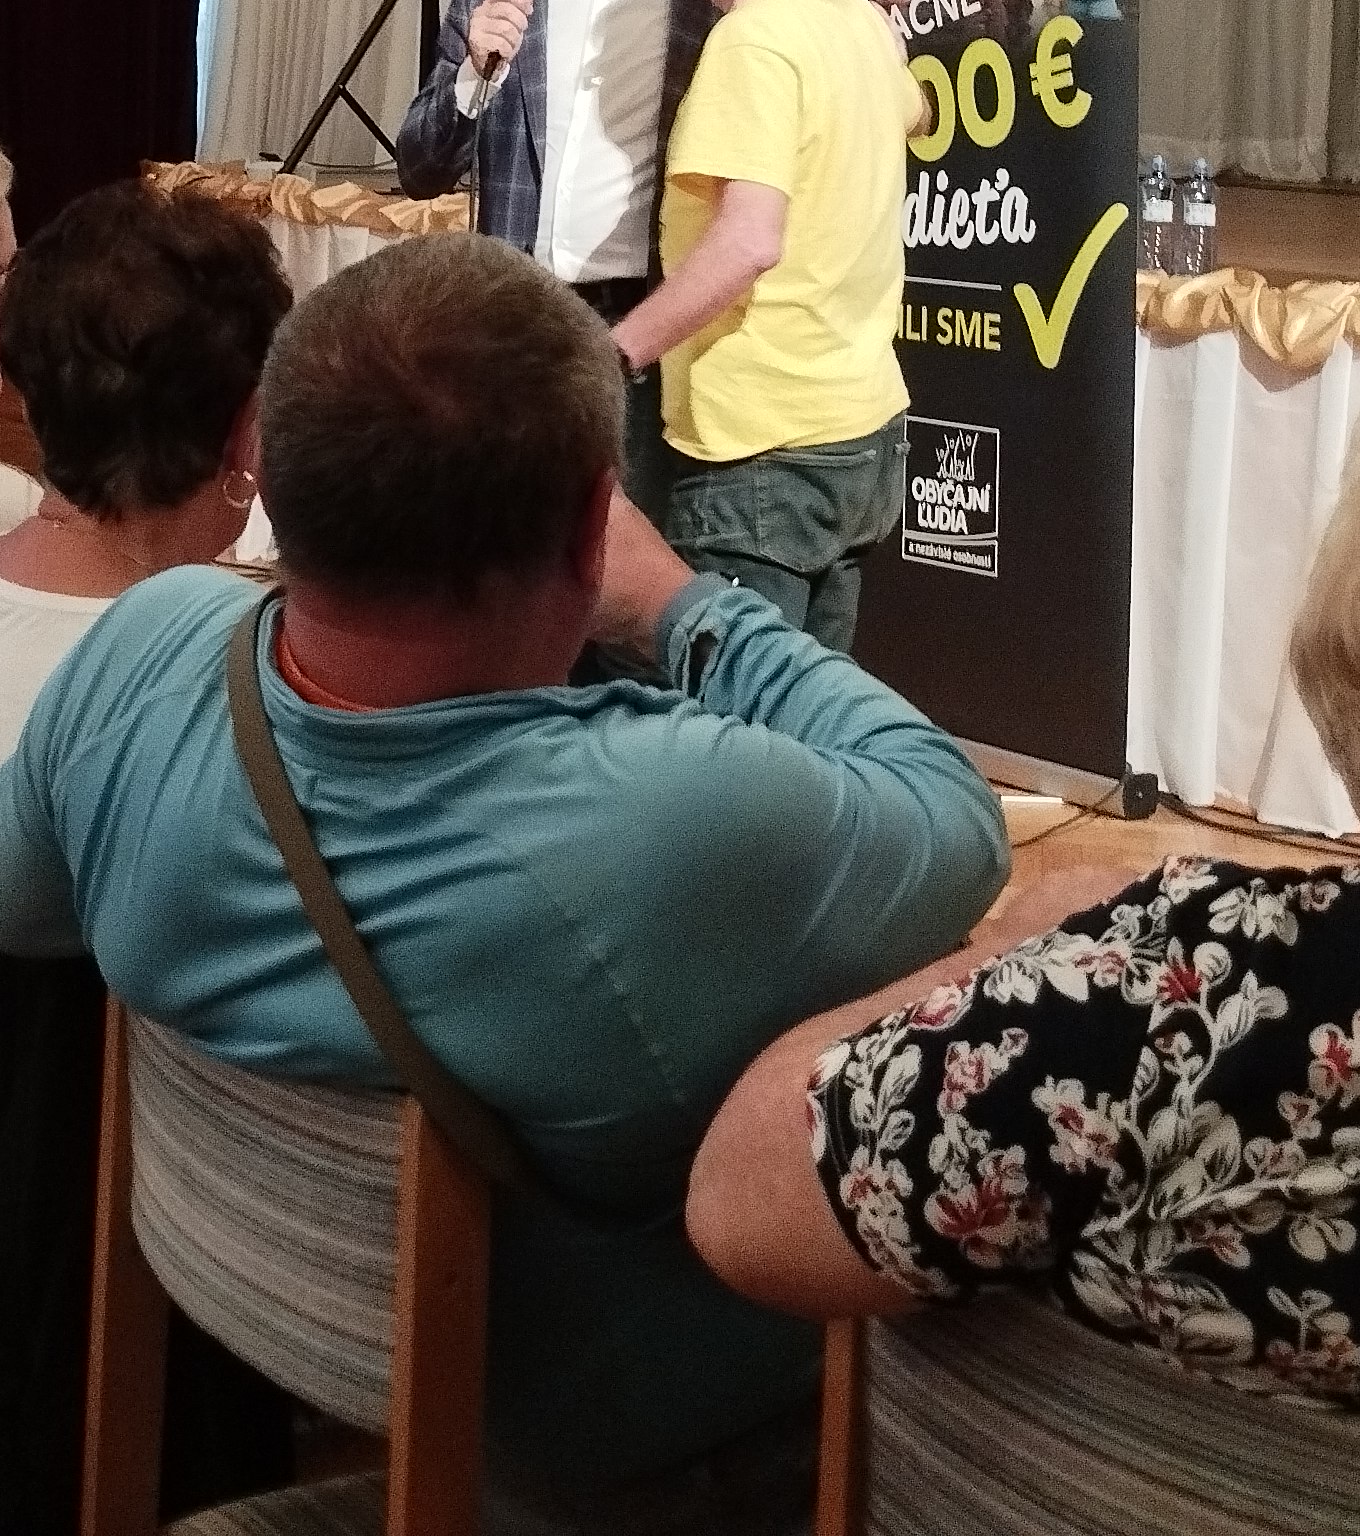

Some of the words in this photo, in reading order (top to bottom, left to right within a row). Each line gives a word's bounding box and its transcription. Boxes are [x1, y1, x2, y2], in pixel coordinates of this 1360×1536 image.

[1029, 14, 1093, 129] €
[902, 167, 1036, 250] dieťa
[936, 306, 1001, 351] SME
[911, 476, 991, 513] OBYČAJNÍ
[917, 501, 968, 535] ĽUDIA
